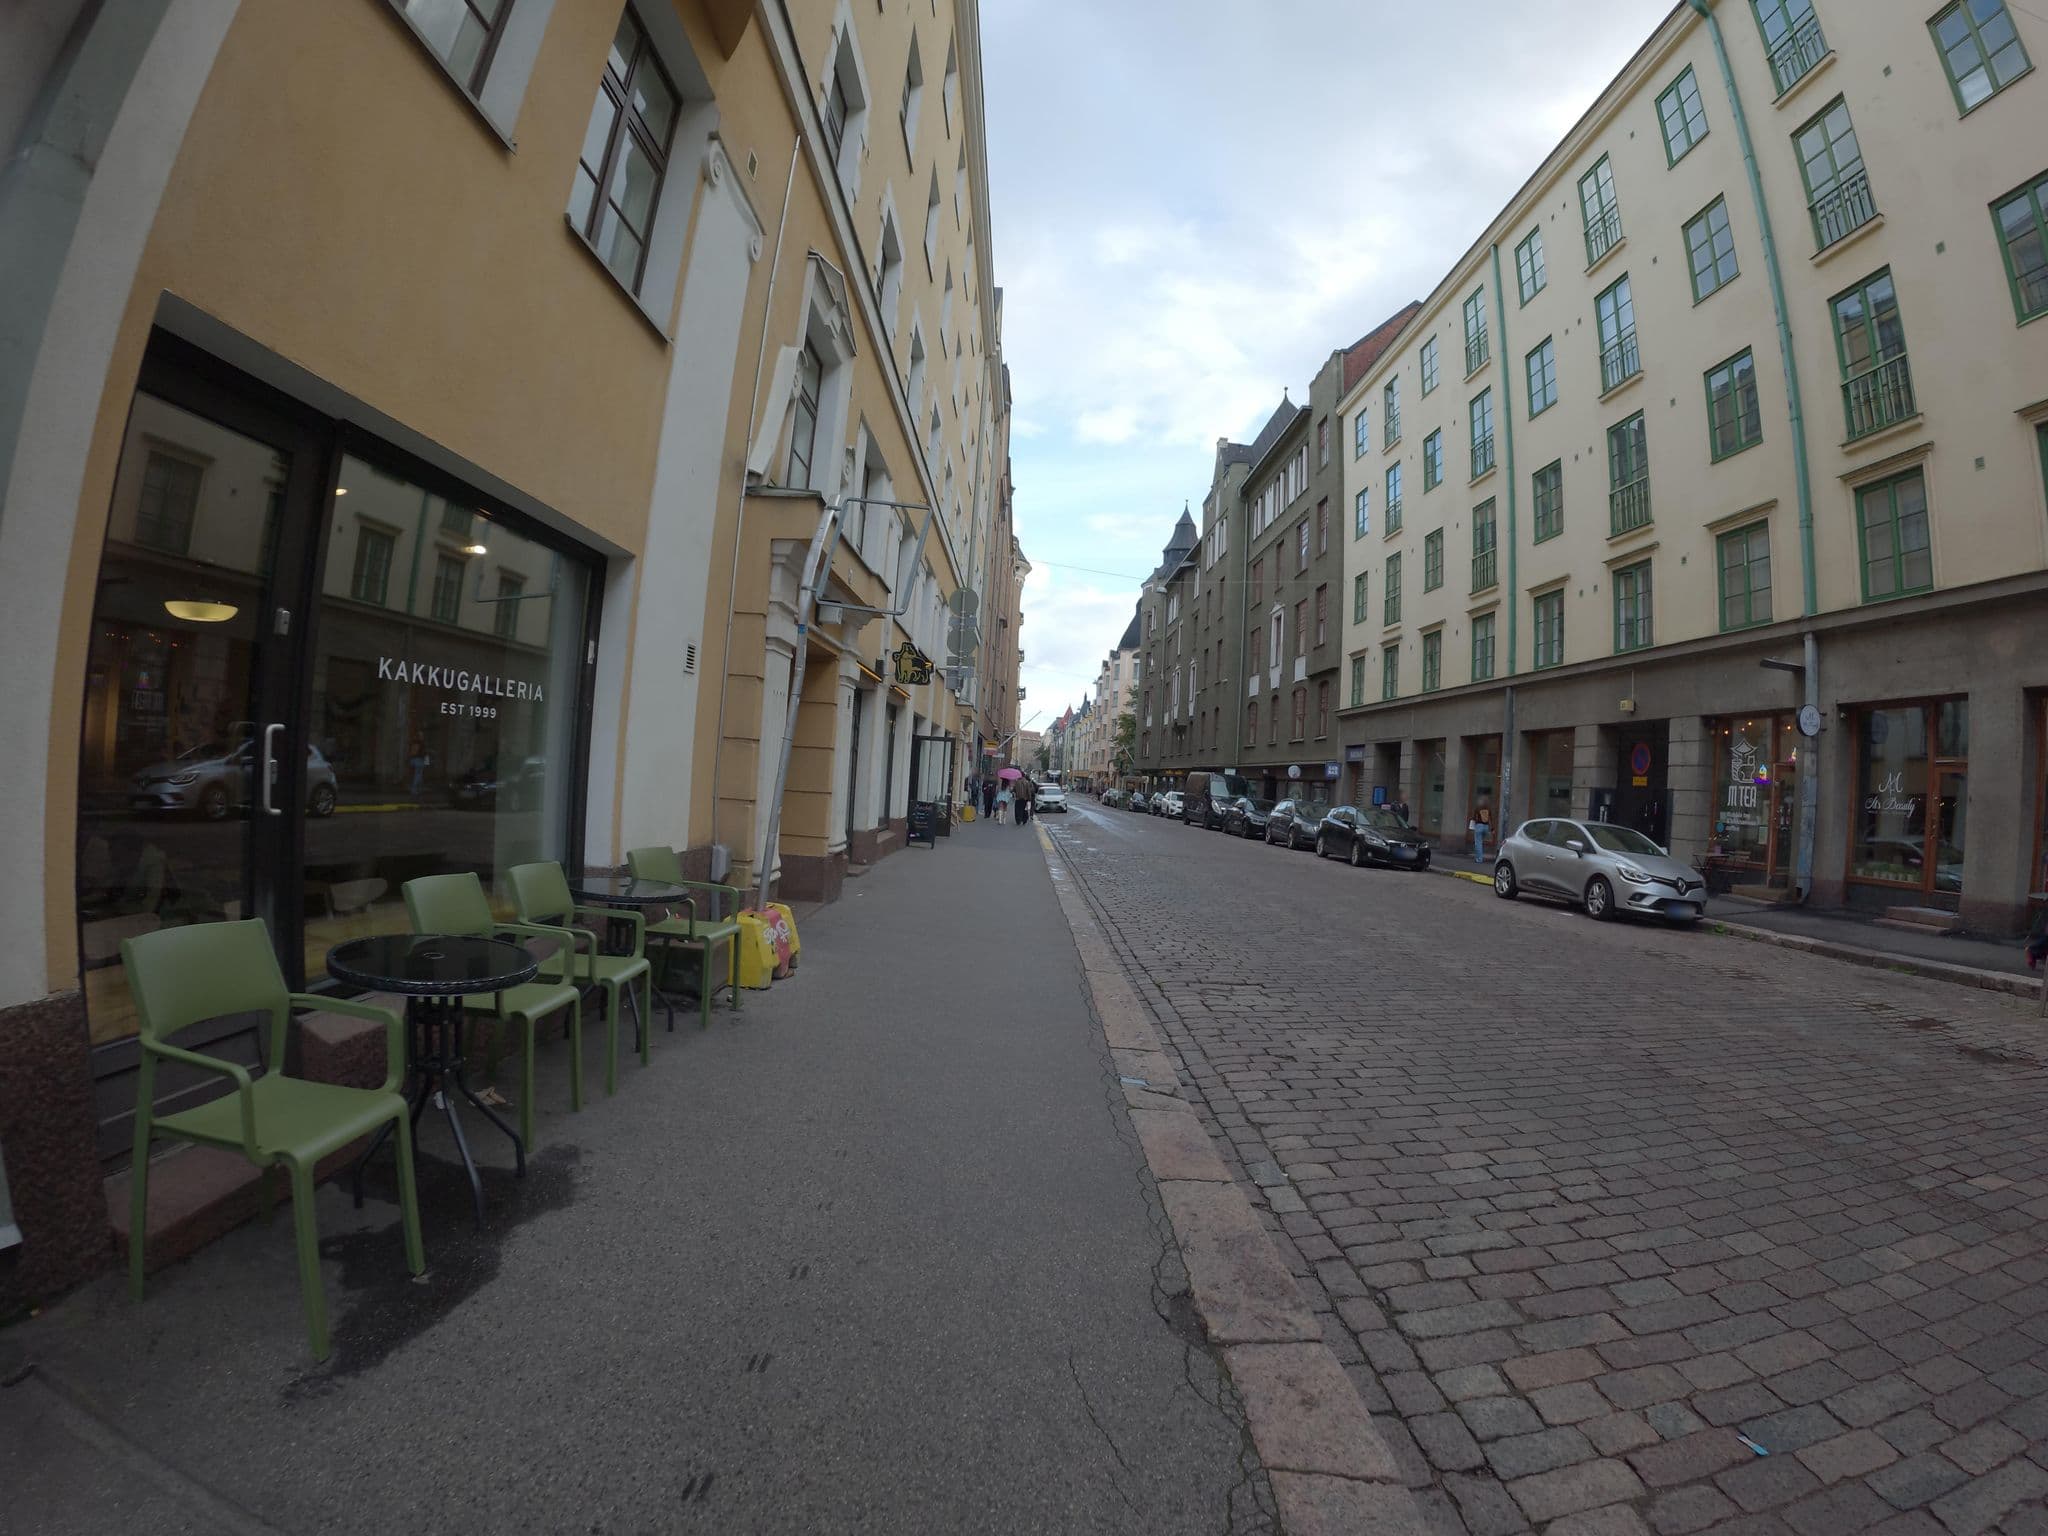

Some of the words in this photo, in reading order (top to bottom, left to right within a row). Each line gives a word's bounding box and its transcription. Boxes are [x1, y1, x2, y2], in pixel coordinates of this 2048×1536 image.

[378, 656, 544, 702] KAKKUGALLERIA
[440, 702, 465, 716] EST
[469, 705, 497, 719] 1999
[1738, 785, 1758, 808] TEA
